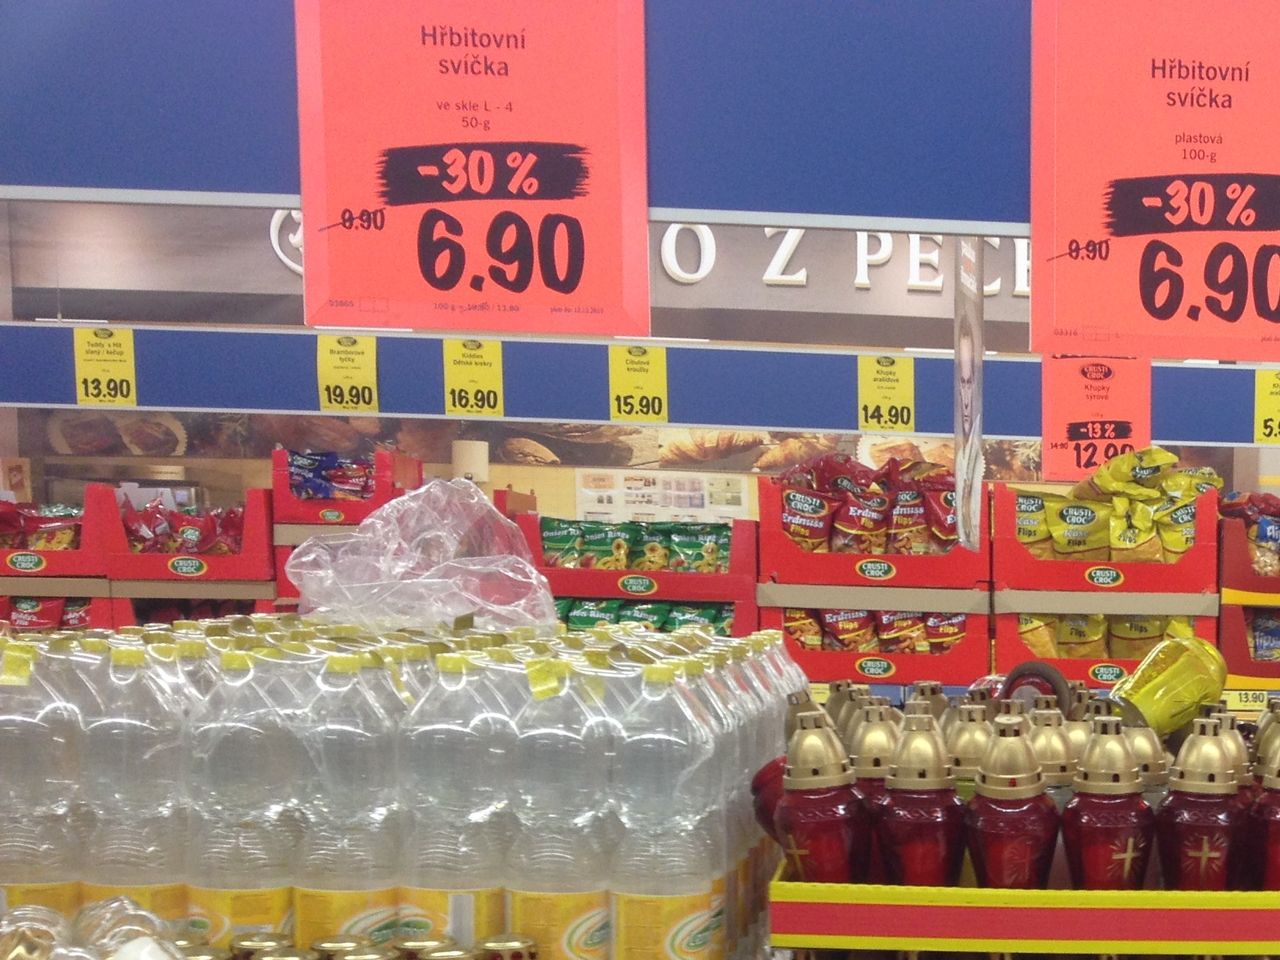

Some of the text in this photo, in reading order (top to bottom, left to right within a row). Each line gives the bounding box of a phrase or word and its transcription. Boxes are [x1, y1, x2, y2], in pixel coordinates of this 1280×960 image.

[420, 25, 527, 49] Hřbitovní
[439, 53, 509, 76] svíčka
[1150, 58, 1250, 82] Hřbitovní
[1166, 87, 1233, 109] svíčka
[436, 102, 450, 111] ve
[455, 100, 479, 112] skle
[483, 101, 491, 112] L
[504, 102, 513, 112] 4
[1175, 131, 1223, 145] plastová
[416, 148, 539, 195] -30 %
[1141, 180, 1256, 226] -30 %
[417, 207, 585, 295] 6.90
[762, 226, 808, 287] Z
[82, 377, 131, 398] 13.90
[324, 384, 373, 406] 19.90
[449, 388, 498, 410] 16.90
[615, 394, 663, 416] 15.90
[862, 404, 911, 425] 14.90
[1080, 422, 1102, 438] -13
[789, 492, 821, 507] CRUSTI
[791, 501, 816, 514] CROC
[849, 506, 884, 520] Erdnu
[893, 505, 925, 516] dnuss
[1063, 507, 1092, 518] CRUSTI
[1066, 515, 1088, 525] CROC
[1017, 527, 1037, 538] Flips
[1066, 537, 1087, 548] Flips
[862, 563, 888, 571] CRUSTI
[865, 569, 885, 577] CROC
[1091, 570, 1117, 578] CRUSTI
[1094, 576, 1113, 584] CROC
[862, 660, 888, 668] CRUSTI
[864, 667, 886, 675] CROC
[1238, 692, 1265, 703] 13.90
